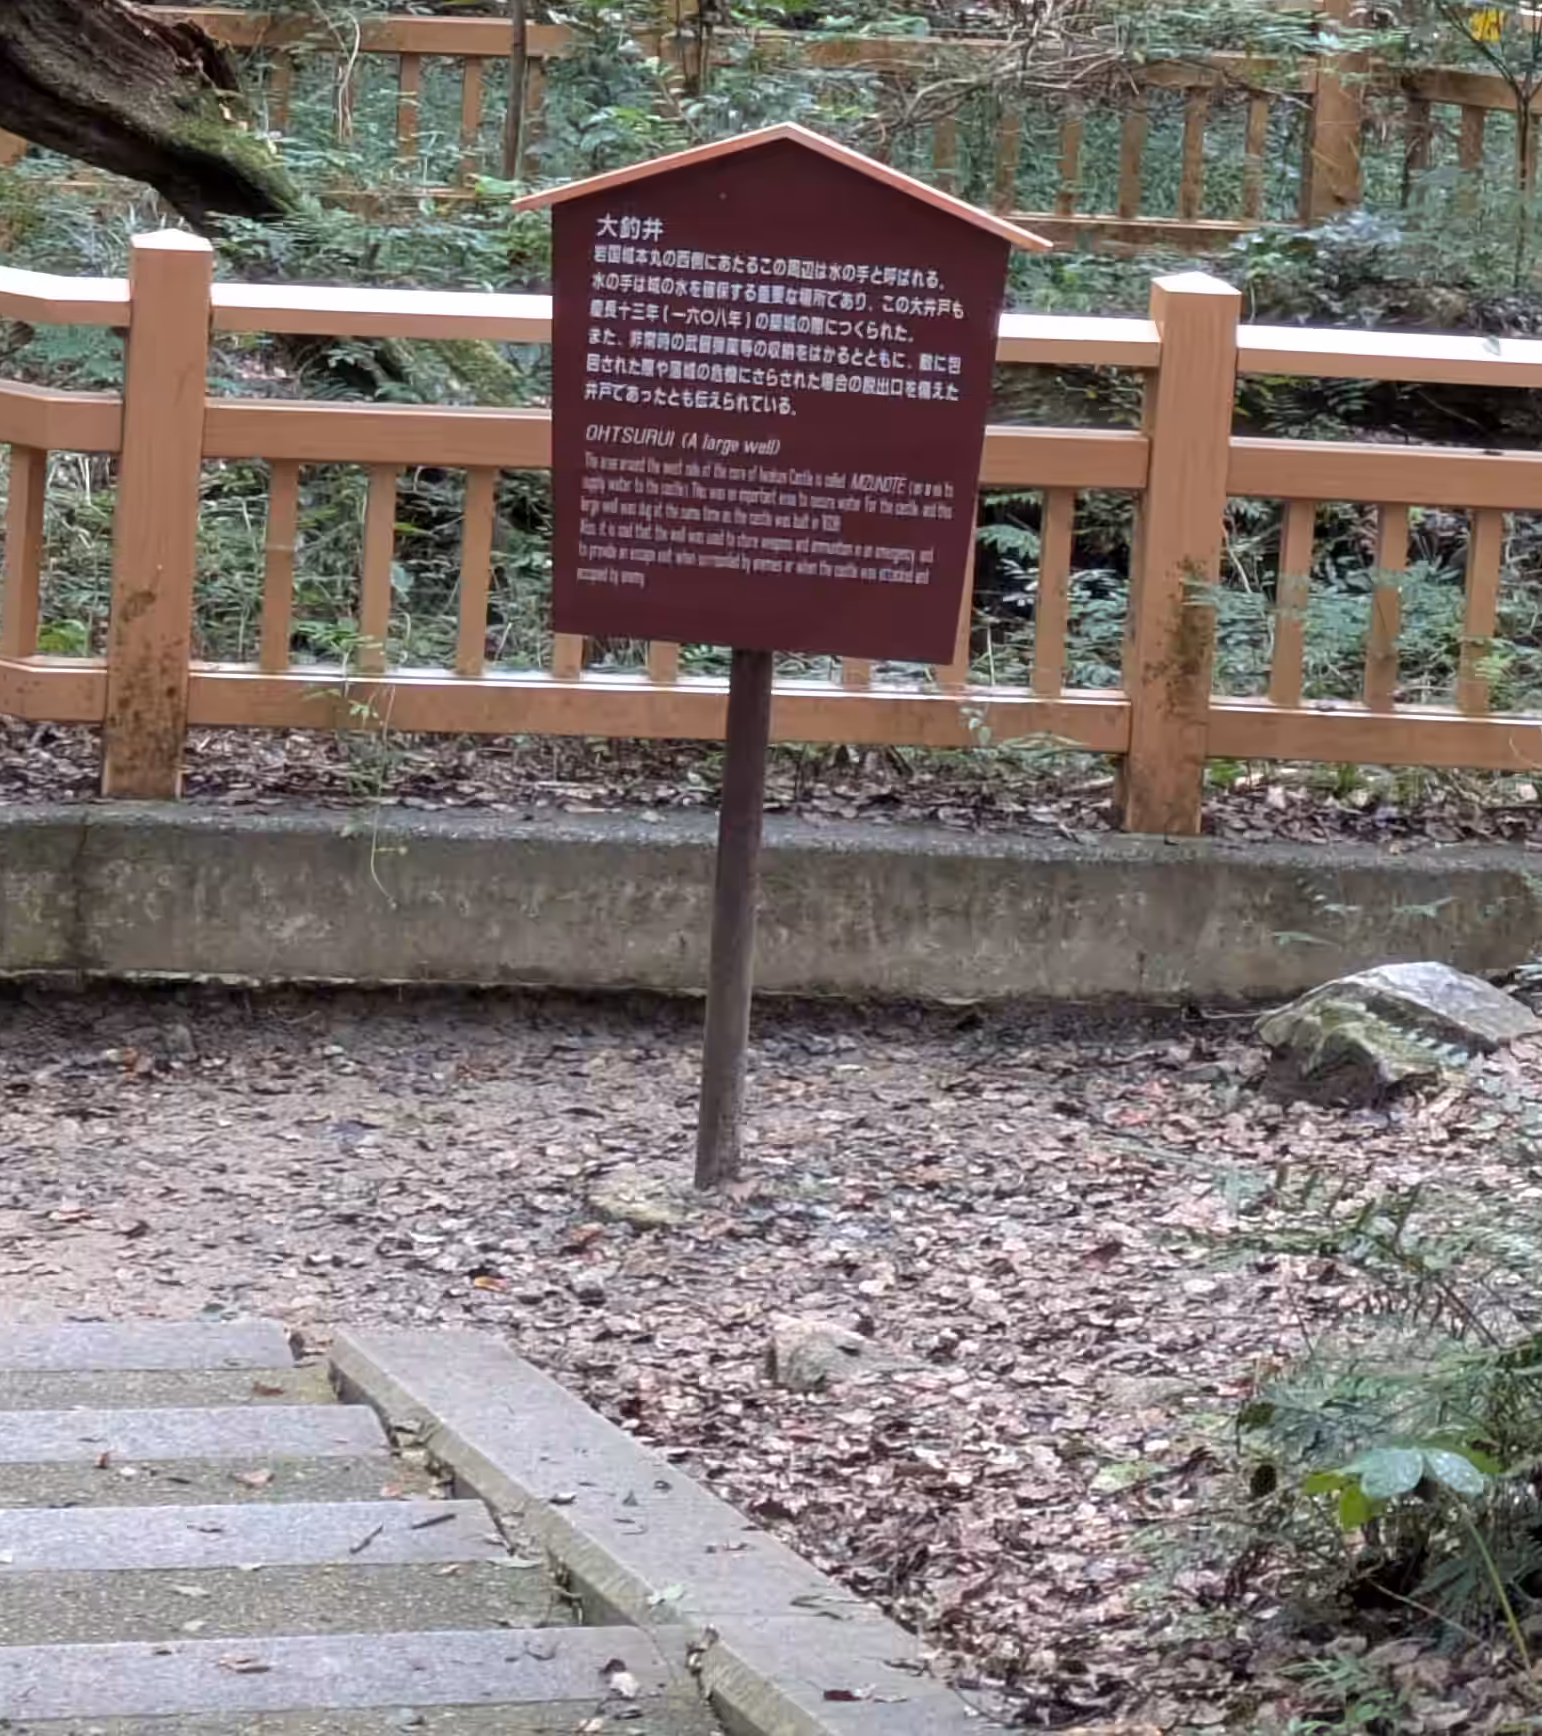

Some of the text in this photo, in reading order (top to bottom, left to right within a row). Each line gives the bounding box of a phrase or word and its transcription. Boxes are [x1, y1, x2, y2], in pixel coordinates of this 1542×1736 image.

[596, 212, 664, 241] 大釣井
[585, 424, 781, 456] OHTSURUI (A large well)
[850, 473, 908, 494] MIZUNOTE
